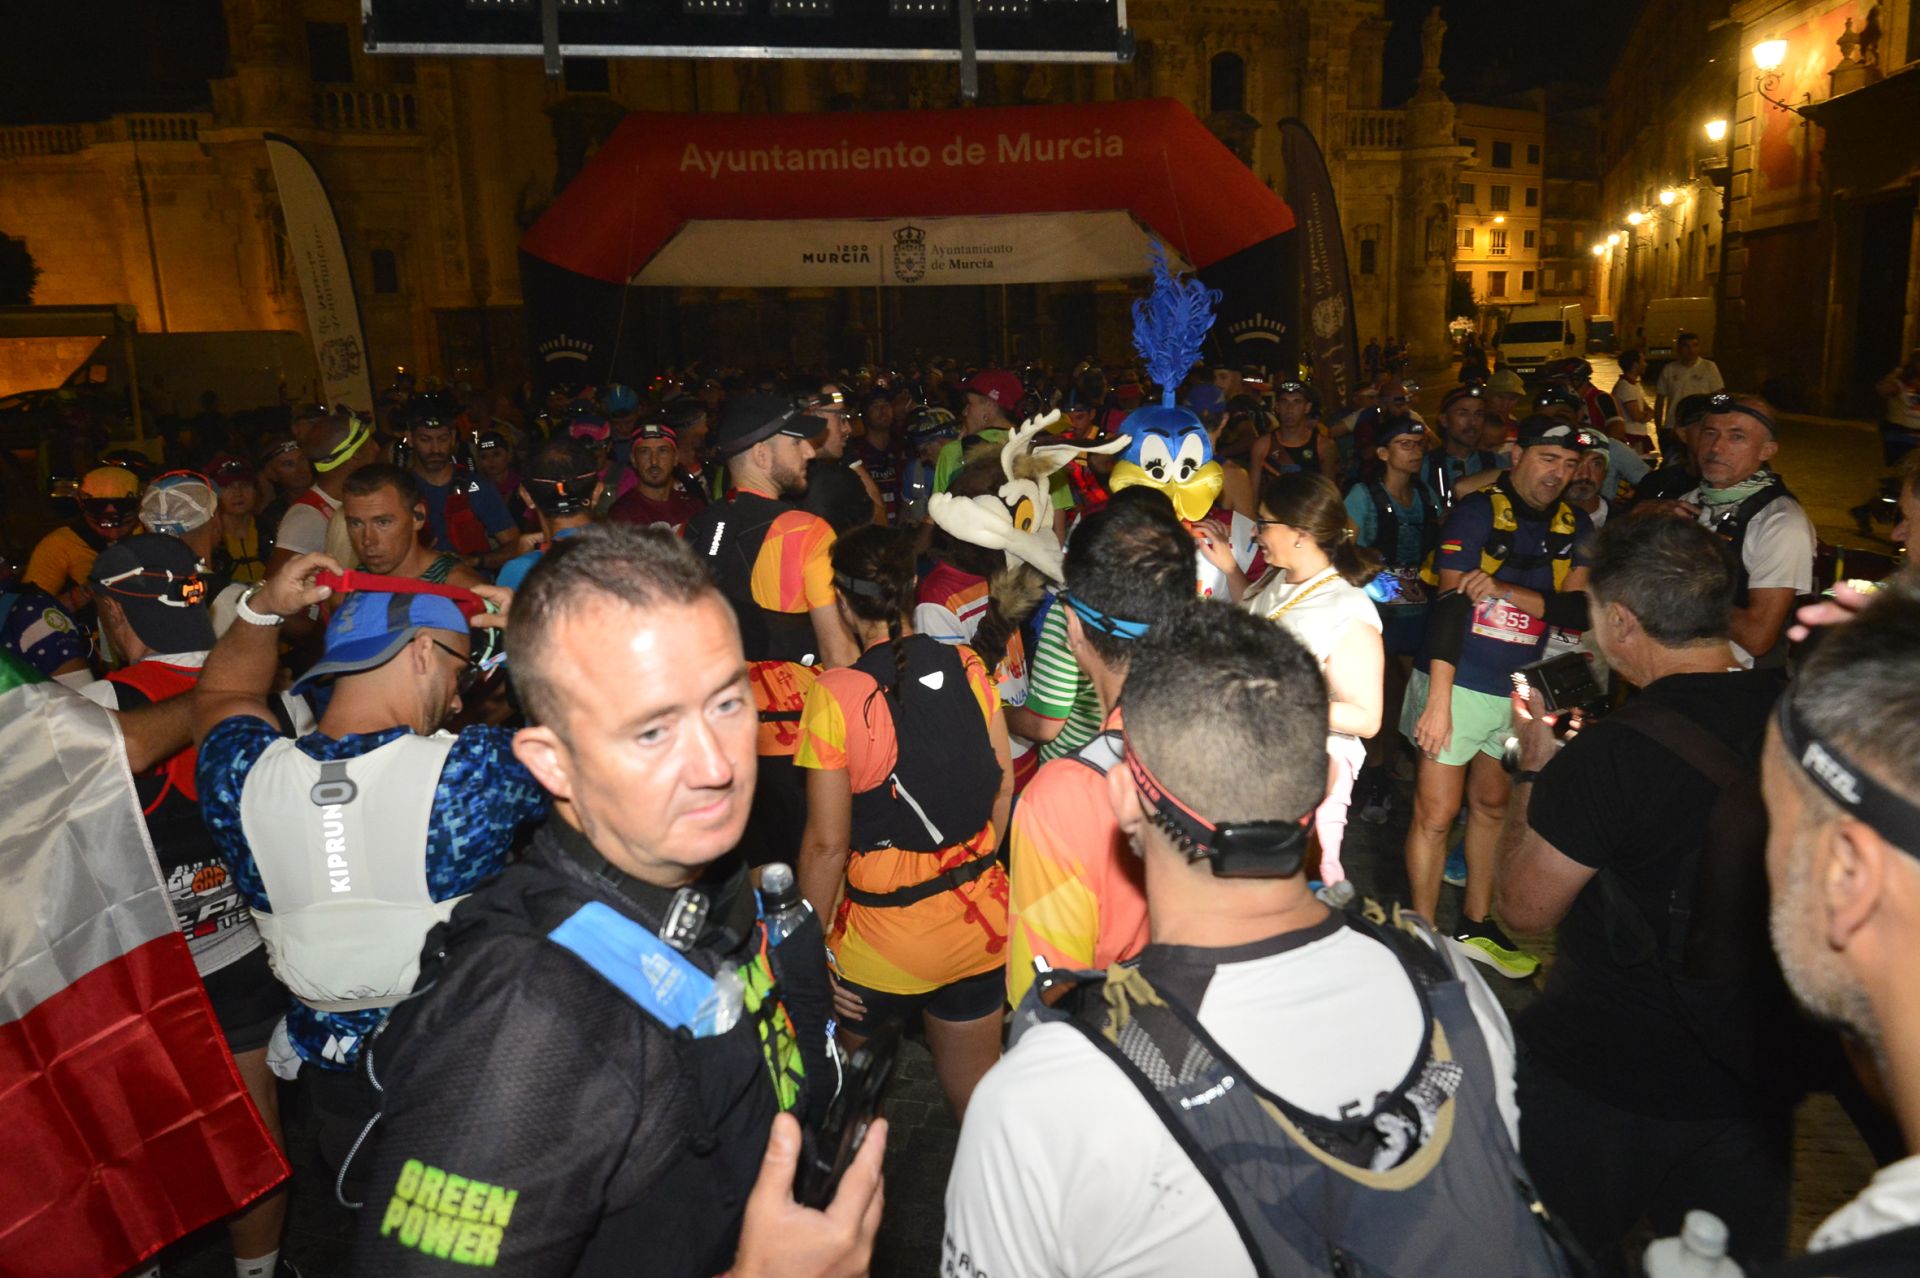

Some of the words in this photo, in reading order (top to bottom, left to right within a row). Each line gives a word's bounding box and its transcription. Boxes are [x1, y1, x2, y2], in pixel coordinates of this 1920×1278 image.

[679, 138, 931, 180] Ayuntamiento
[941, 135, 987, 167] de
[997, 127, 1125, 164] Murcia
[802, 252, 871, 264] MURCIA
[836, 244, 869, 252] 1200
[931, 259, 946, 271] de
[949, 258, 994, 270] Murcia
[932, 243, 1014, 257] Ayuntamiento
[321, 804, 352, 893] KIPRUN
[395, 1157, 519, 1228] GREEN
[379, 1194, 504, 1268] POWER
